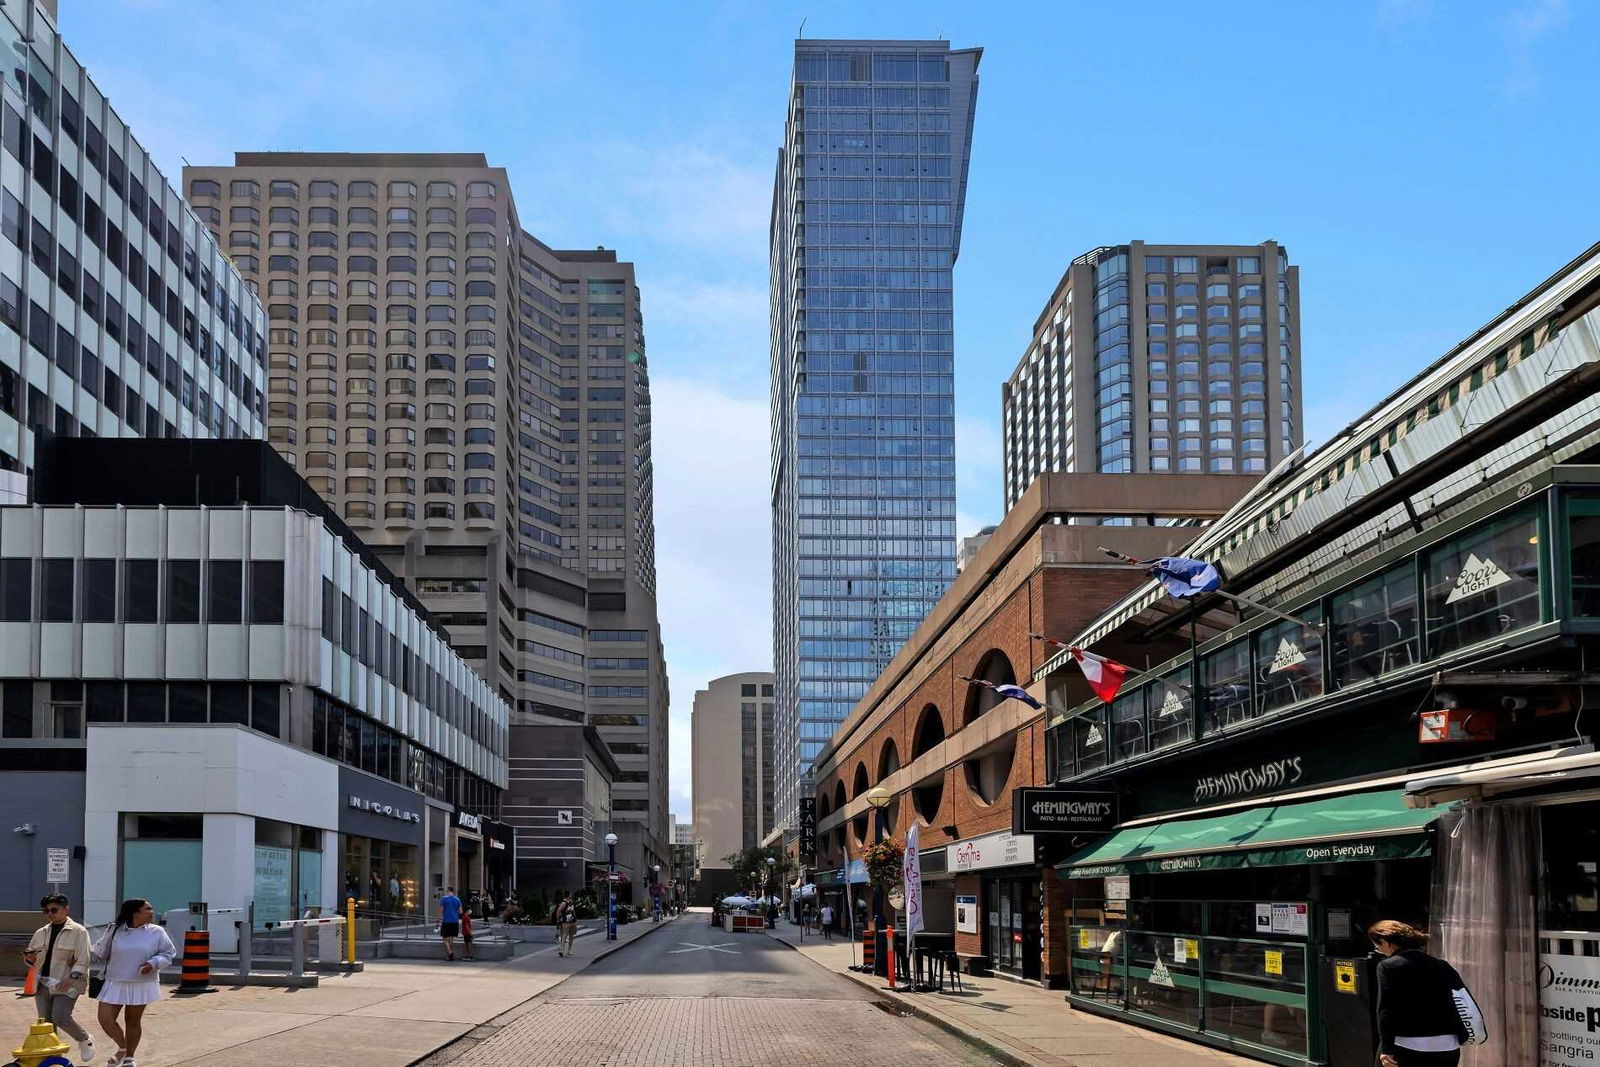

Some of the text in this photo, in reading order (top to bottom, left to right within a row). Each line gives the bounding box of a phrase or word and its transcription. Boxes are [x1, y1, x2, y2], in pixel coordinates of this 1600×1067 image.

[1455, 566, 1500, 589] Coors
[1462, 577, 1491, 595] LIGHT
[1194, 757, 1303, 803] HEMINGWAY'S
[348, 796, 420, 823] NICOLAS
[1032, 801, 1111, 815] HEMINGWAY'S
[805, 800, 814, 851] PARK
[1306, 844, 1375, 859] Open Everyday
[1540, 1038, 1594, 1059] Sangria
[1549, 1031, 1583, 1045] bottling
